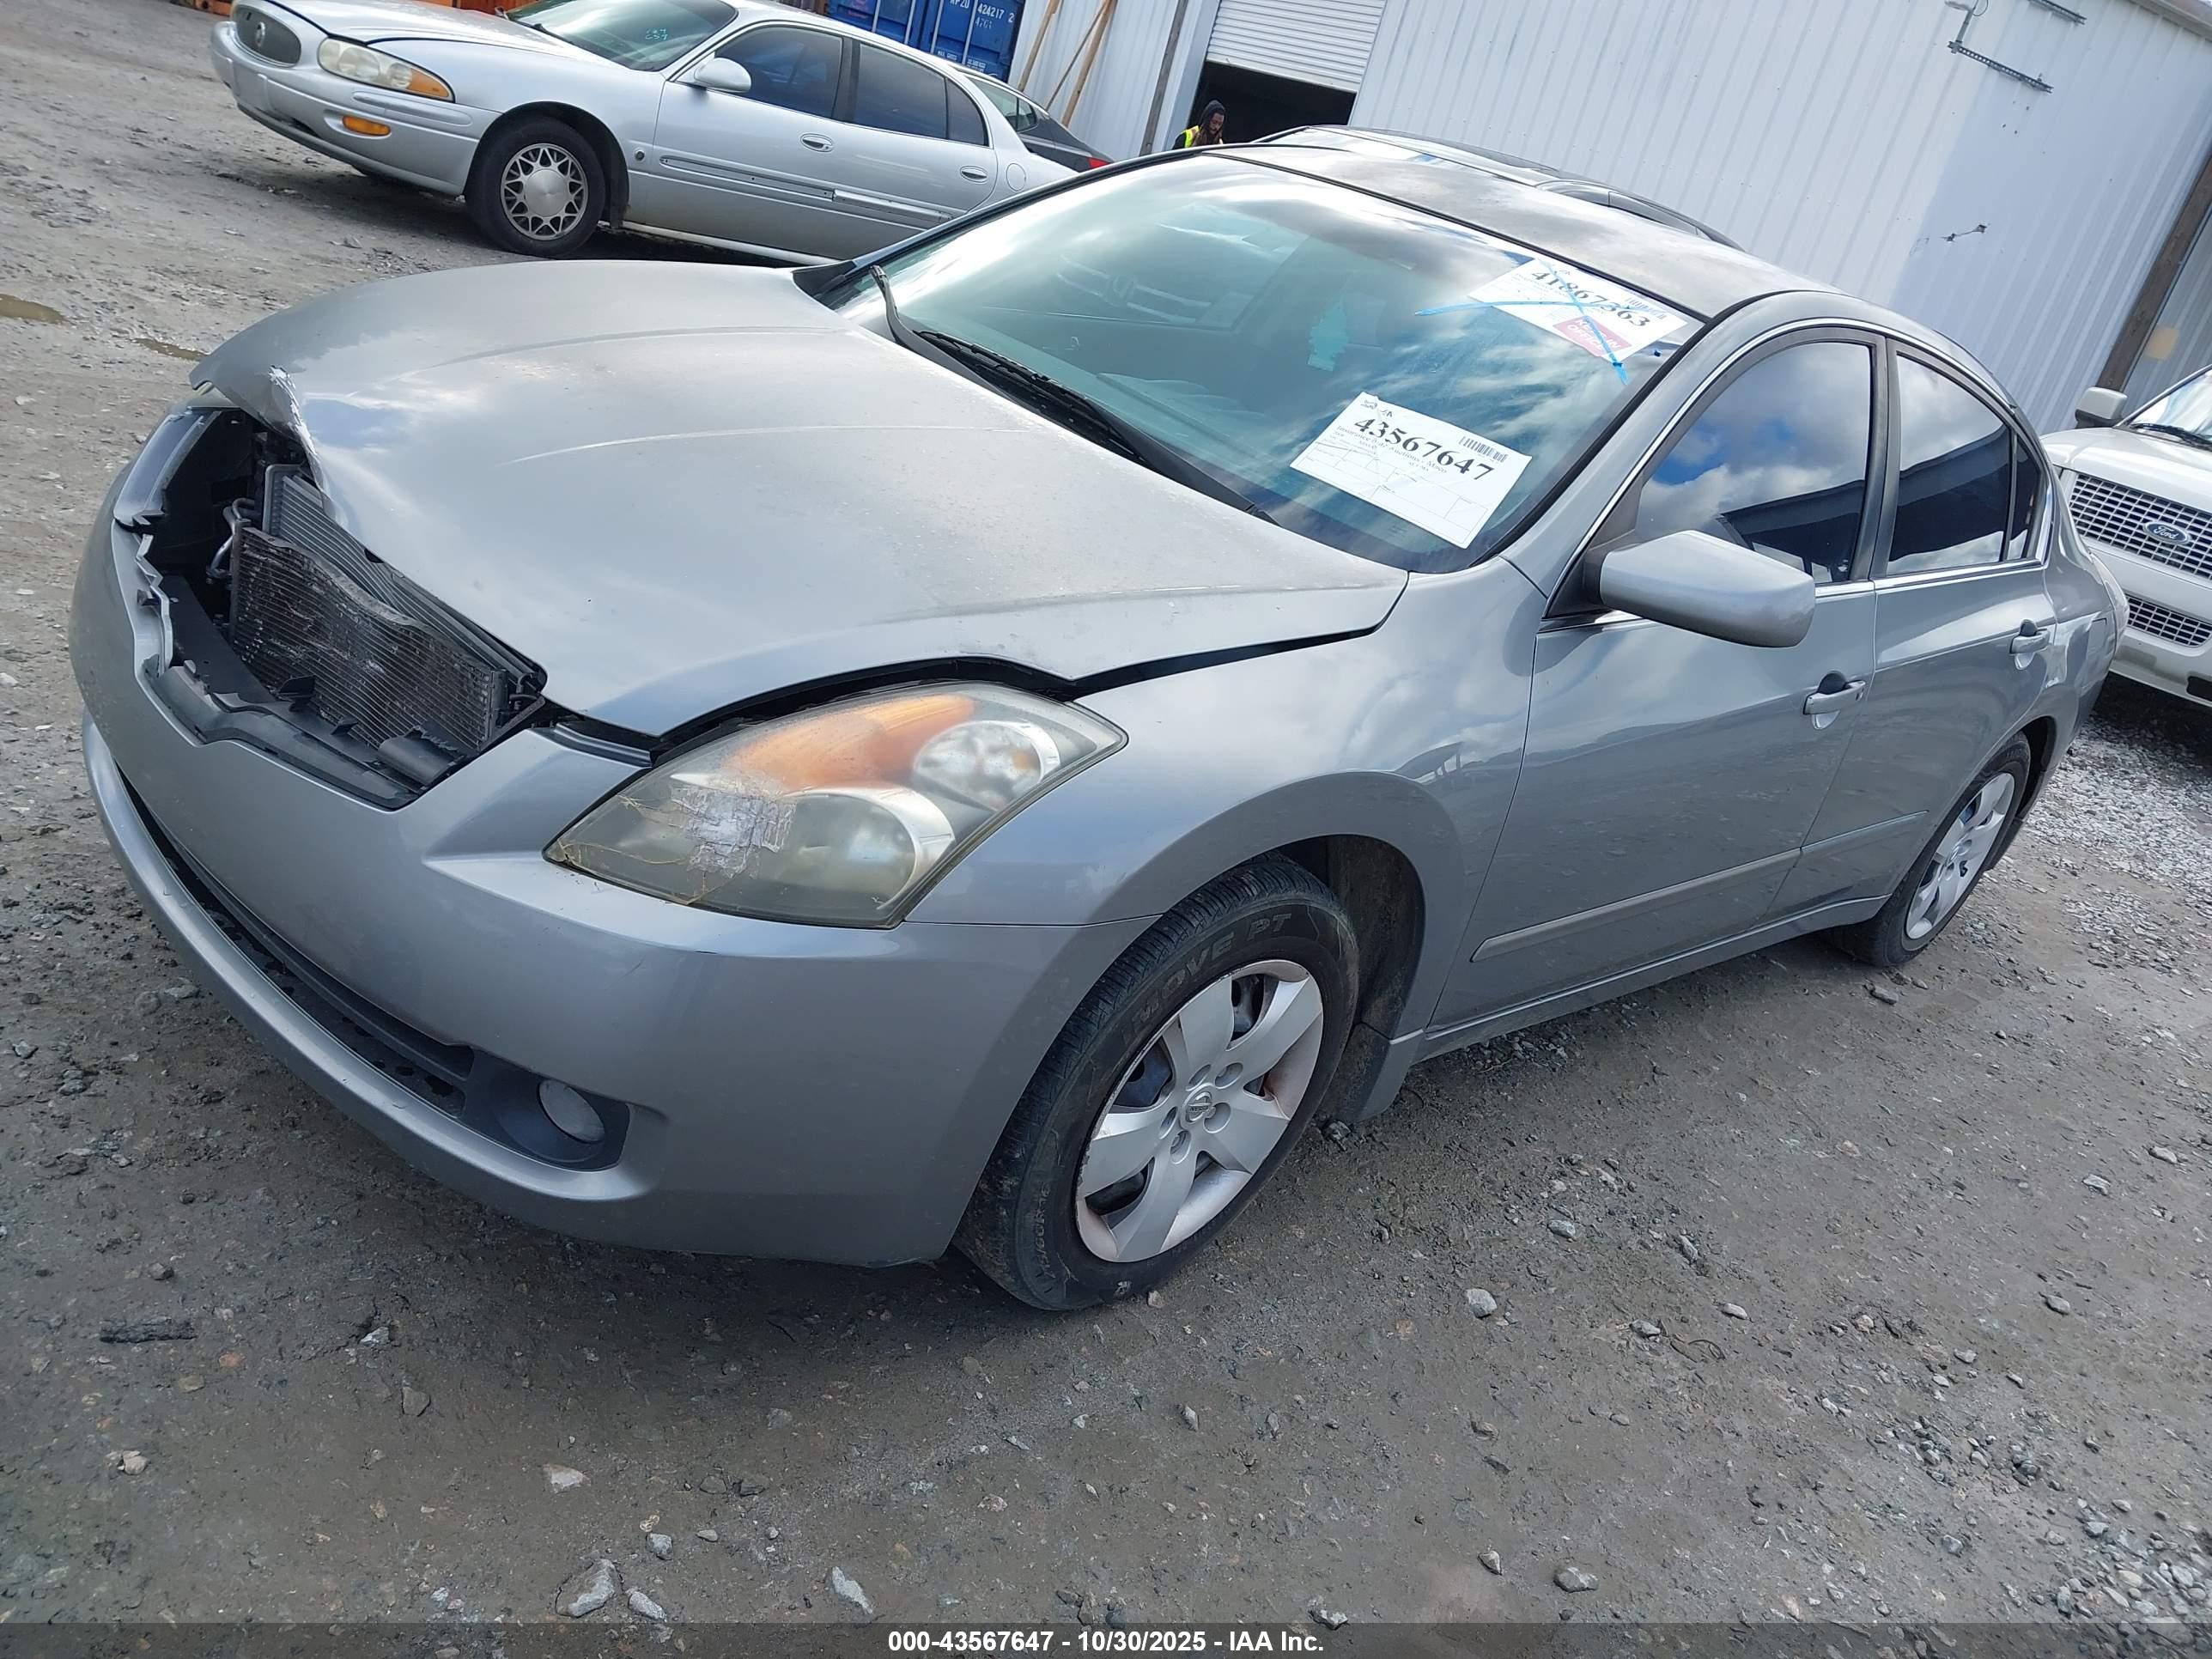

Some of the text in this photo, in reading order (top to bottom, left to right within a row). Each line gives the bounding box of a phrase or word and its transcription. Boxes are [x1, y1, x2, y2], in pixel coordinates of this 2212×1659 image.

[978, 3, 1005, 19] 424217
[1007, 13, 1015, 23] 2
[1353, 418, 1495, 480] 43567647
[2154, 526, 2179, 539] Ford
[1247, 913, 1291, 941] PT
